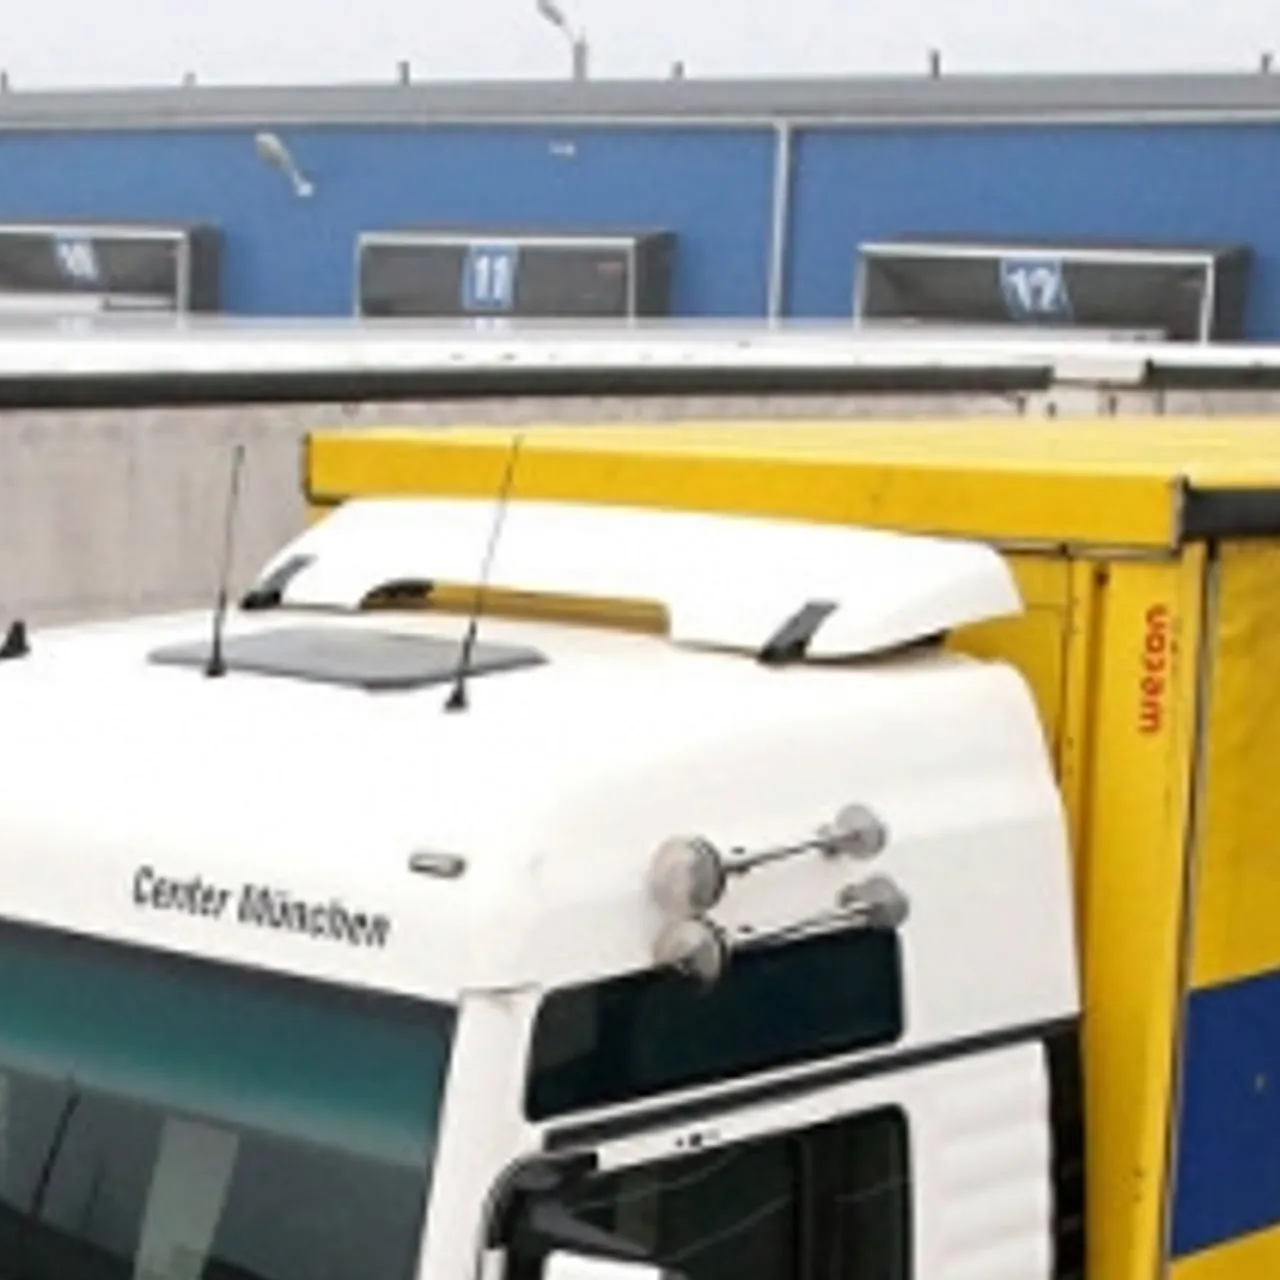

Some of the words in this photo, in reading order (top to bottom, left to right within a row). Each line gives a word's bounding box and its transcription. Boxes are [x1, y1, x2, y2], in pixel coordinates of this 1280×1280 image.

[474, 255, 512, 300] 11
[1137, 602, 1169, 734] wecon
[132, 864, 232, 919] Center
[237, 882, 393, 949] München
